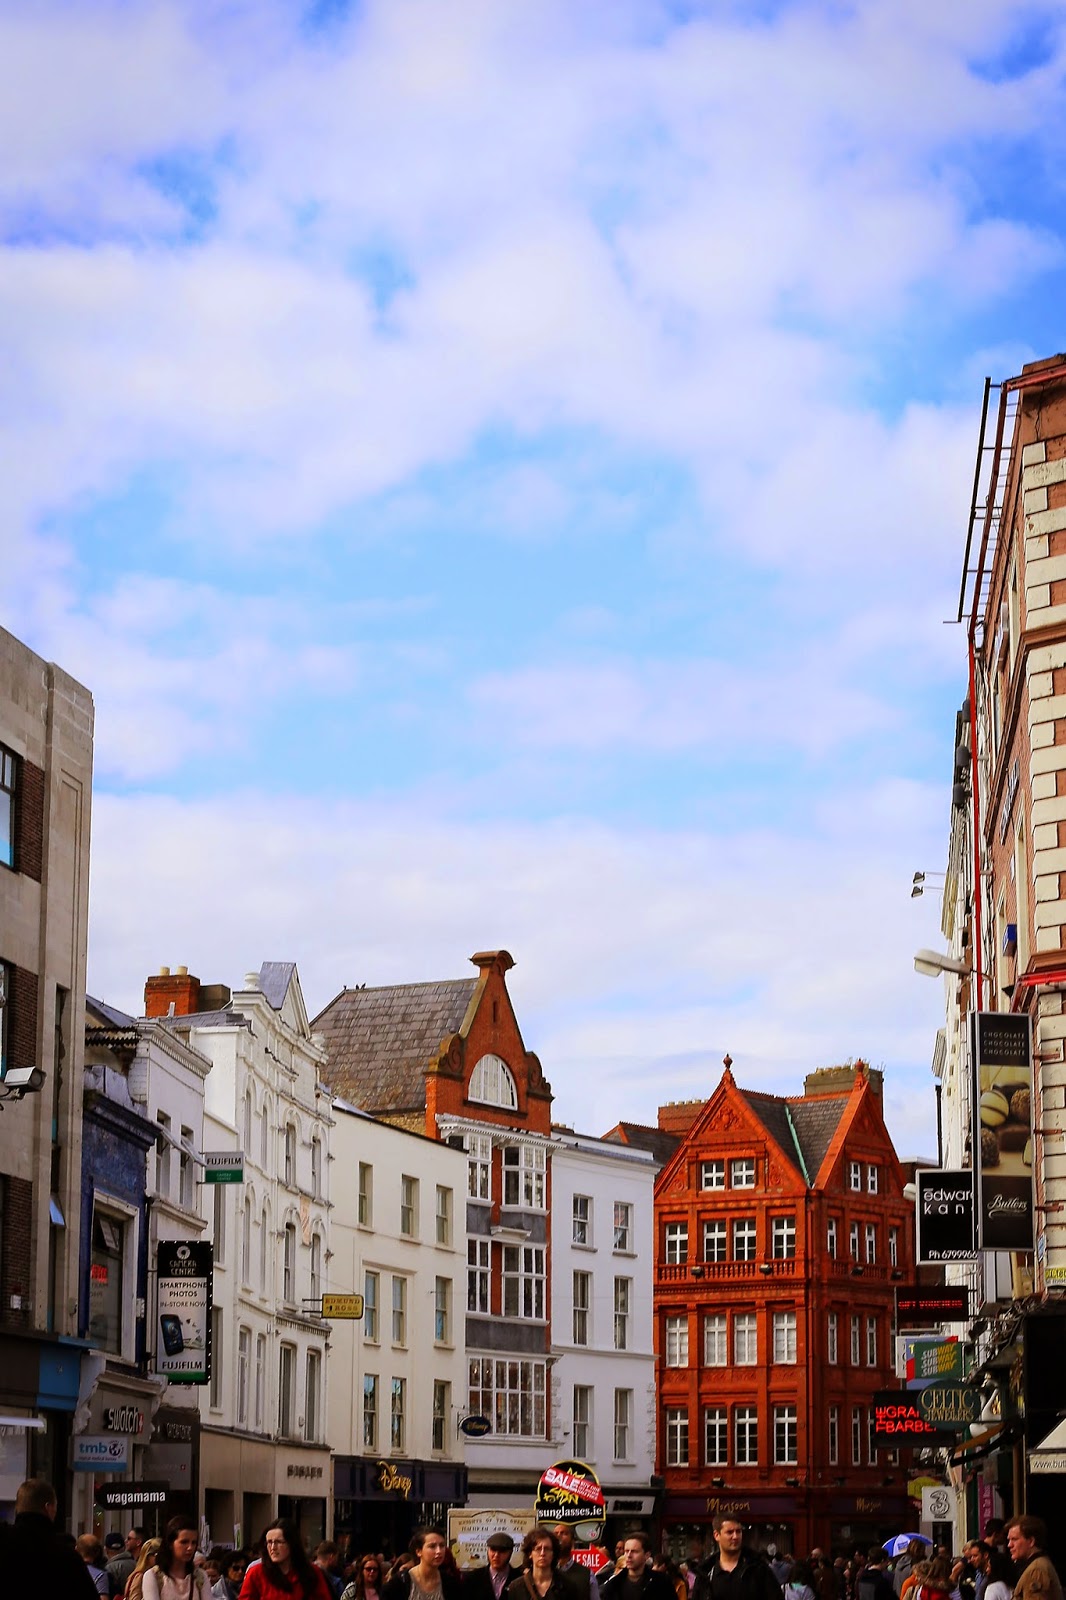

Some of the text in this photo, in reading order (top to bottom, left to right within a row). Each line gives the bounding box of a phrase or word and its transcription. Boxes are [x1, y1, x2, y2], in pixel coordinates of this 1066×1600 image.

[983, 1032, 1025, 1040] CHOCOLATE
[983, 1040, 1025, 1048] CHOCOLATE
[206, 1158, 241, 1166] FUJIFILM
[923, 1204, 974, 1215] kan
[987, 1193, 1028, 1212] Butlers
[928, 1250, 940, 1259] Ph
[169, 1260, 197, 1268] CAMERA
[169, 1290, 198, 1298] PHOTOS
[921, 1343, 957, 1360] SUBWAY
[162, 1361, 203, 1370] FUJIFILM
[921, 1351, 957, 1368] SUBWAY
[921, 1360, 957, 1377] SUBWAY
[921, 1389, 974, 1410] CELTIC
[107, 1406, 139, 1433] swatch
[886, 1406, 920, 1419] GRA
[79, 1442, 108, 1454] tmb
[376, 1461, 412, 1501] Disney
[544, 1469, 580, 1492] SALE
[106, 1491, 166, 1505] wagamama
[537, 1505, 602, 1519] sunglasses.ie
[706, 1497, 750, 1514] Monsoon
[582, 1553, 600, 1567] SALE
